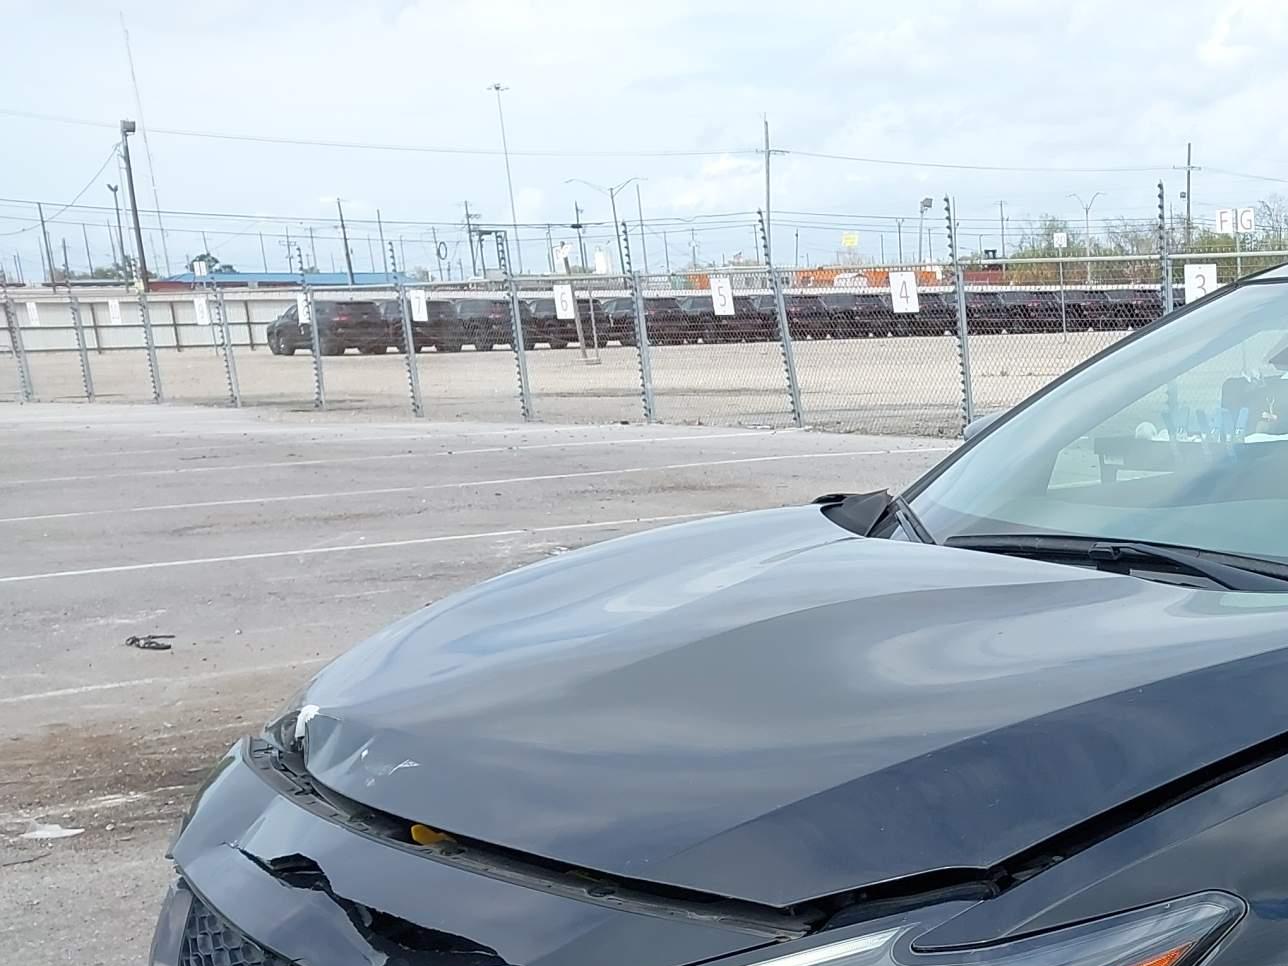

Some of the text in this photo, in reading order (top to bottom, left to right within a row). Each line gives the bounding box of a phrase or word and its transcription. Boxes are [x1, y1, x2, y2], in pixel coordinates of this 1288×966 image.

[1219, 210, 1252, 231] F G
[899, 279, 911, 305] 4
[1194, 273, 1207, 295] 3
[559, 291, 569, 313] 6
[715, 285, 728, 308] 5
